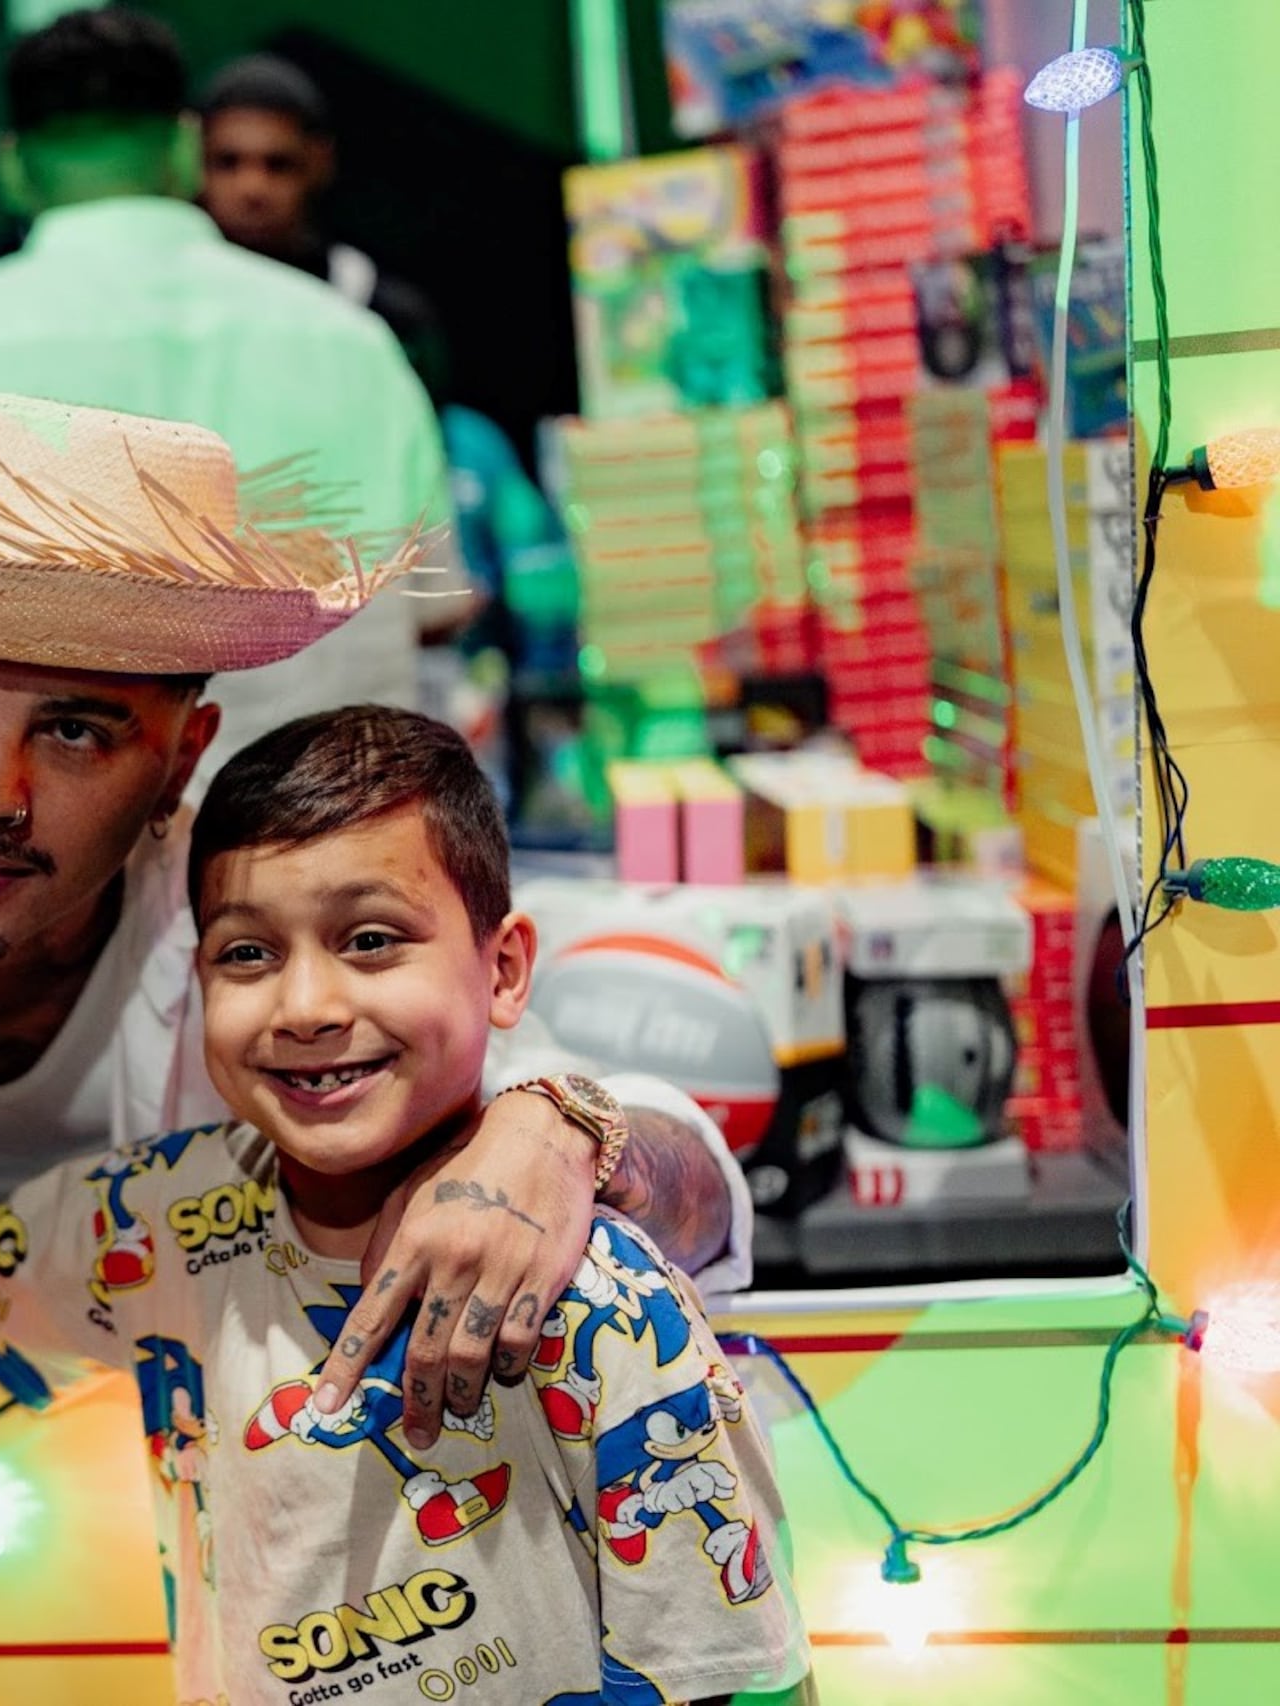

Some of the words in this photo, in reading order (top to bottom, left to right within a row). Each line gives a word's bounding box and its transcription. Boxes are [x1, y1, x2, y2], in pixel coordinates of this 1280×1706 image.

[258, 1568, 477, 1684] SONIC
[289, 1683, 344, 1706] Gotta
[347, 1671, 375, 1694] go
[377, 1652, 423, 1680] fast
